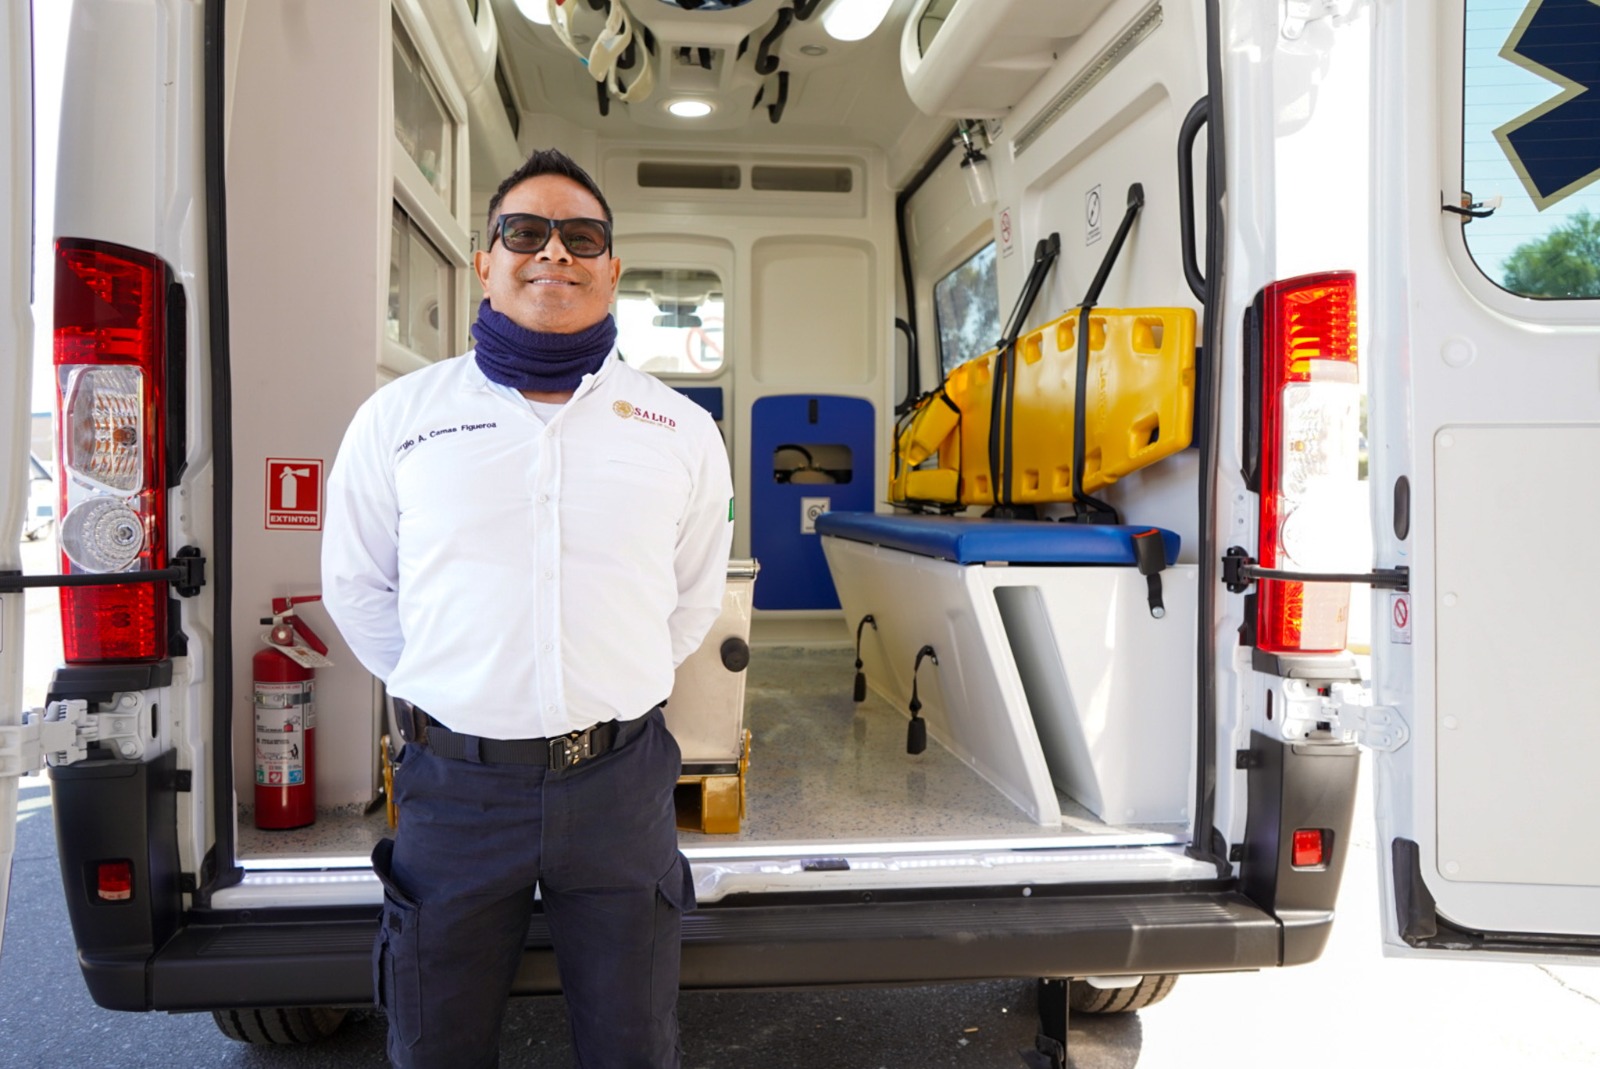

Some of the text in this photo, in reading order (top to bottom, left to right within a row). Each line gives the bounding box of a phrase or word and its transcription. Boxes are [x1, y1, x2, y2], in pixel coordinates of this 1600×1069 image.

[634, 407, 676, 427] SALUD
[418, 435, 427, 443] A.
[429, 427, 457, 438] Camas
[461, 422, 497, 431] Figueroa
[270, 515, 317, 523] EXTINTOR
